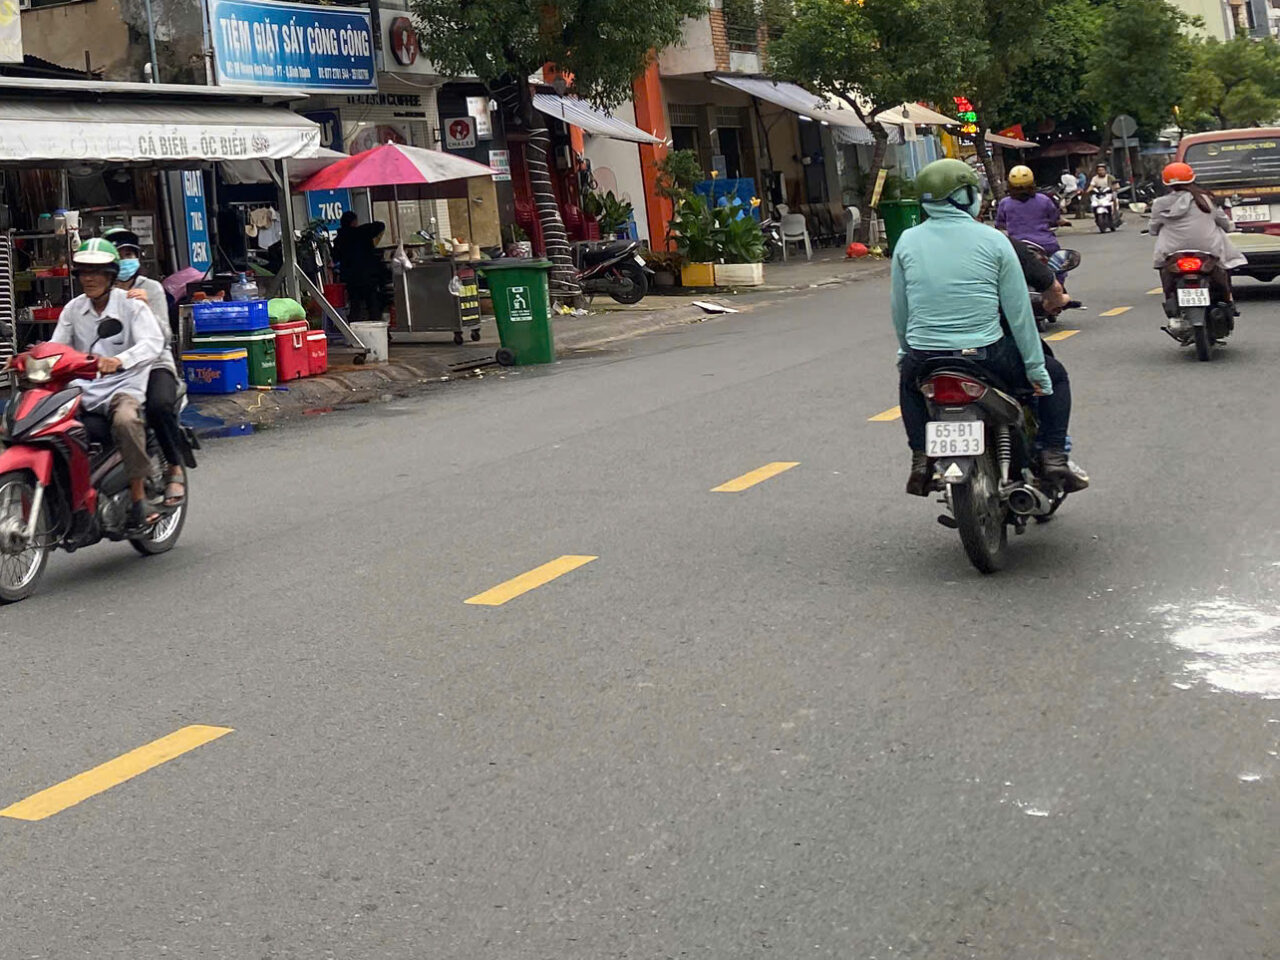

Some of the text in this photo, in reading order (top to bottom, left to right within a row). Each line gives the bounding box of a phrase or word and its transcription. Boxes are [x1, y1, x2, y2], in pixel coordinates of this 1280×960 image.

[220, 13, 370, 62] TIỆM GIẶT SẤY CÔNG CỘNG
[138, 131, 157, 155] CÁ
[161, 128, 189, 155] BIỂN
[200, 130, 217, 155] ỐC
[220, 128, 247, 156] BIỂN
[318, 201, 343, 221] 7KG
[192, 241, 208, 263] 25K
[195, 368, 222, 383] Tiger
[935, 423, 973, 438] 65-B1
[930, 438, 980, 454] 286.33
